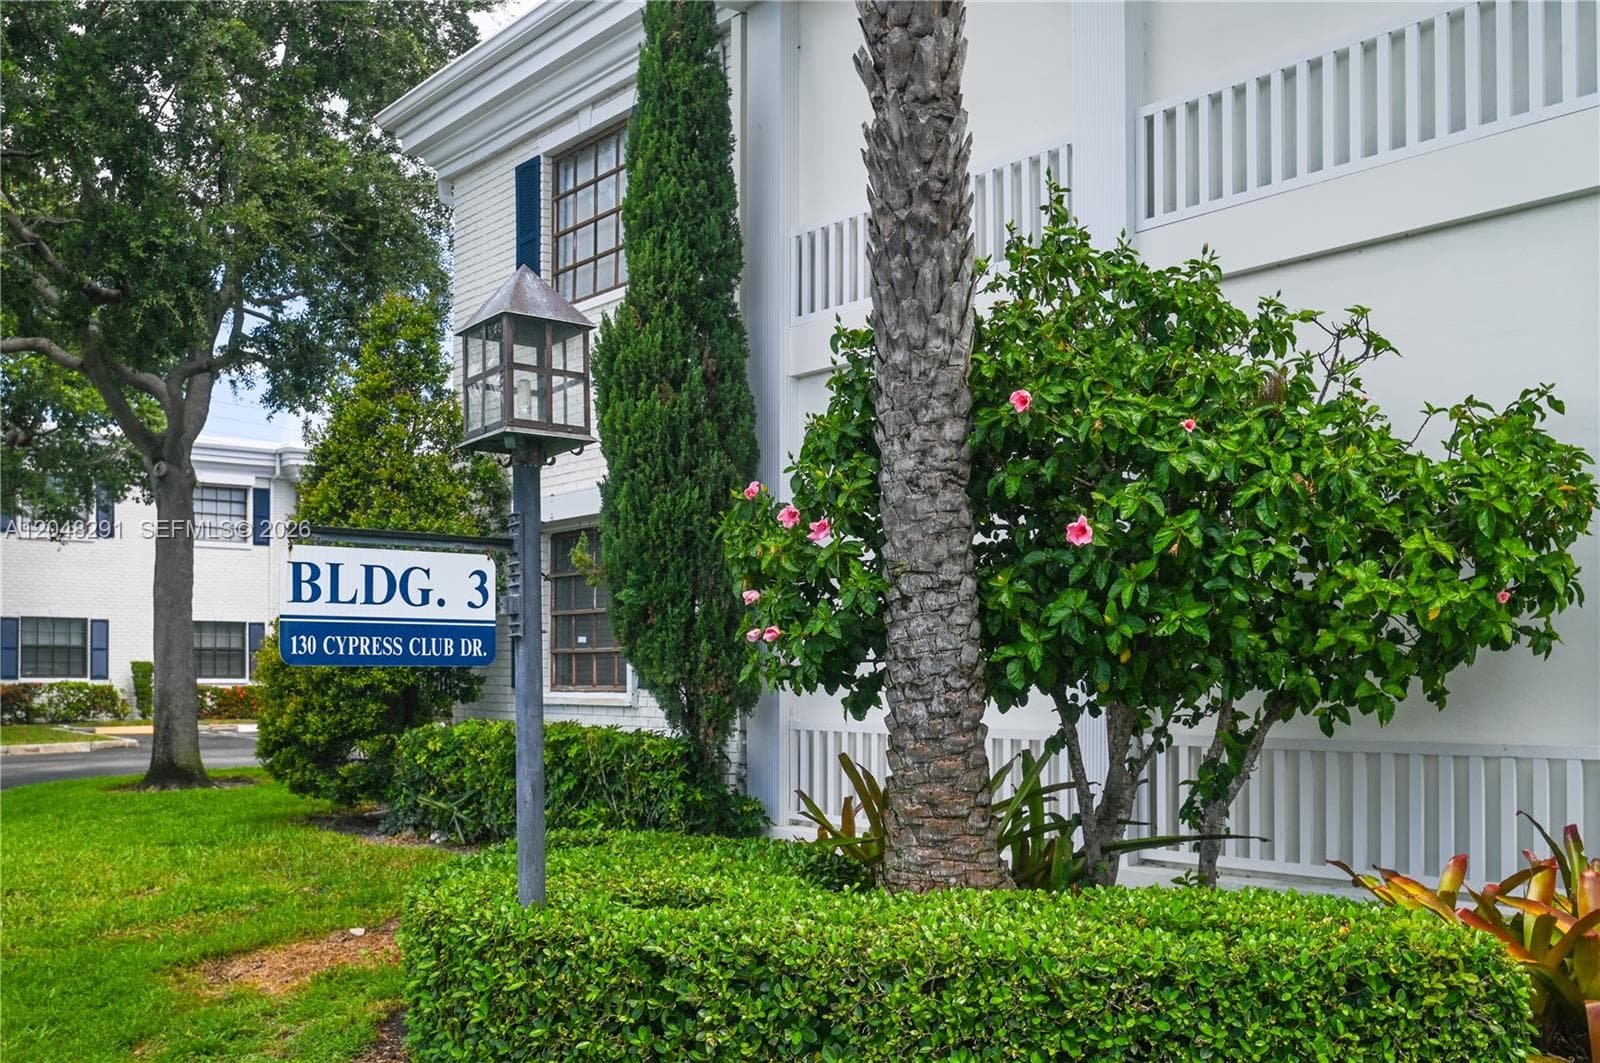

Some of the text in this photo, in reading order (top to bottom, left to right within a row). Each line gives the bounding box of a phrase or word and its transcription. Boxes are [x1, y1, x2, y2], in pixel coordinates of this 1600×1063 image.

[287, 561, 489, 609] BLDG. 3
[290, 634, 487, 657] 130 CYPRESS CLUB DR.
